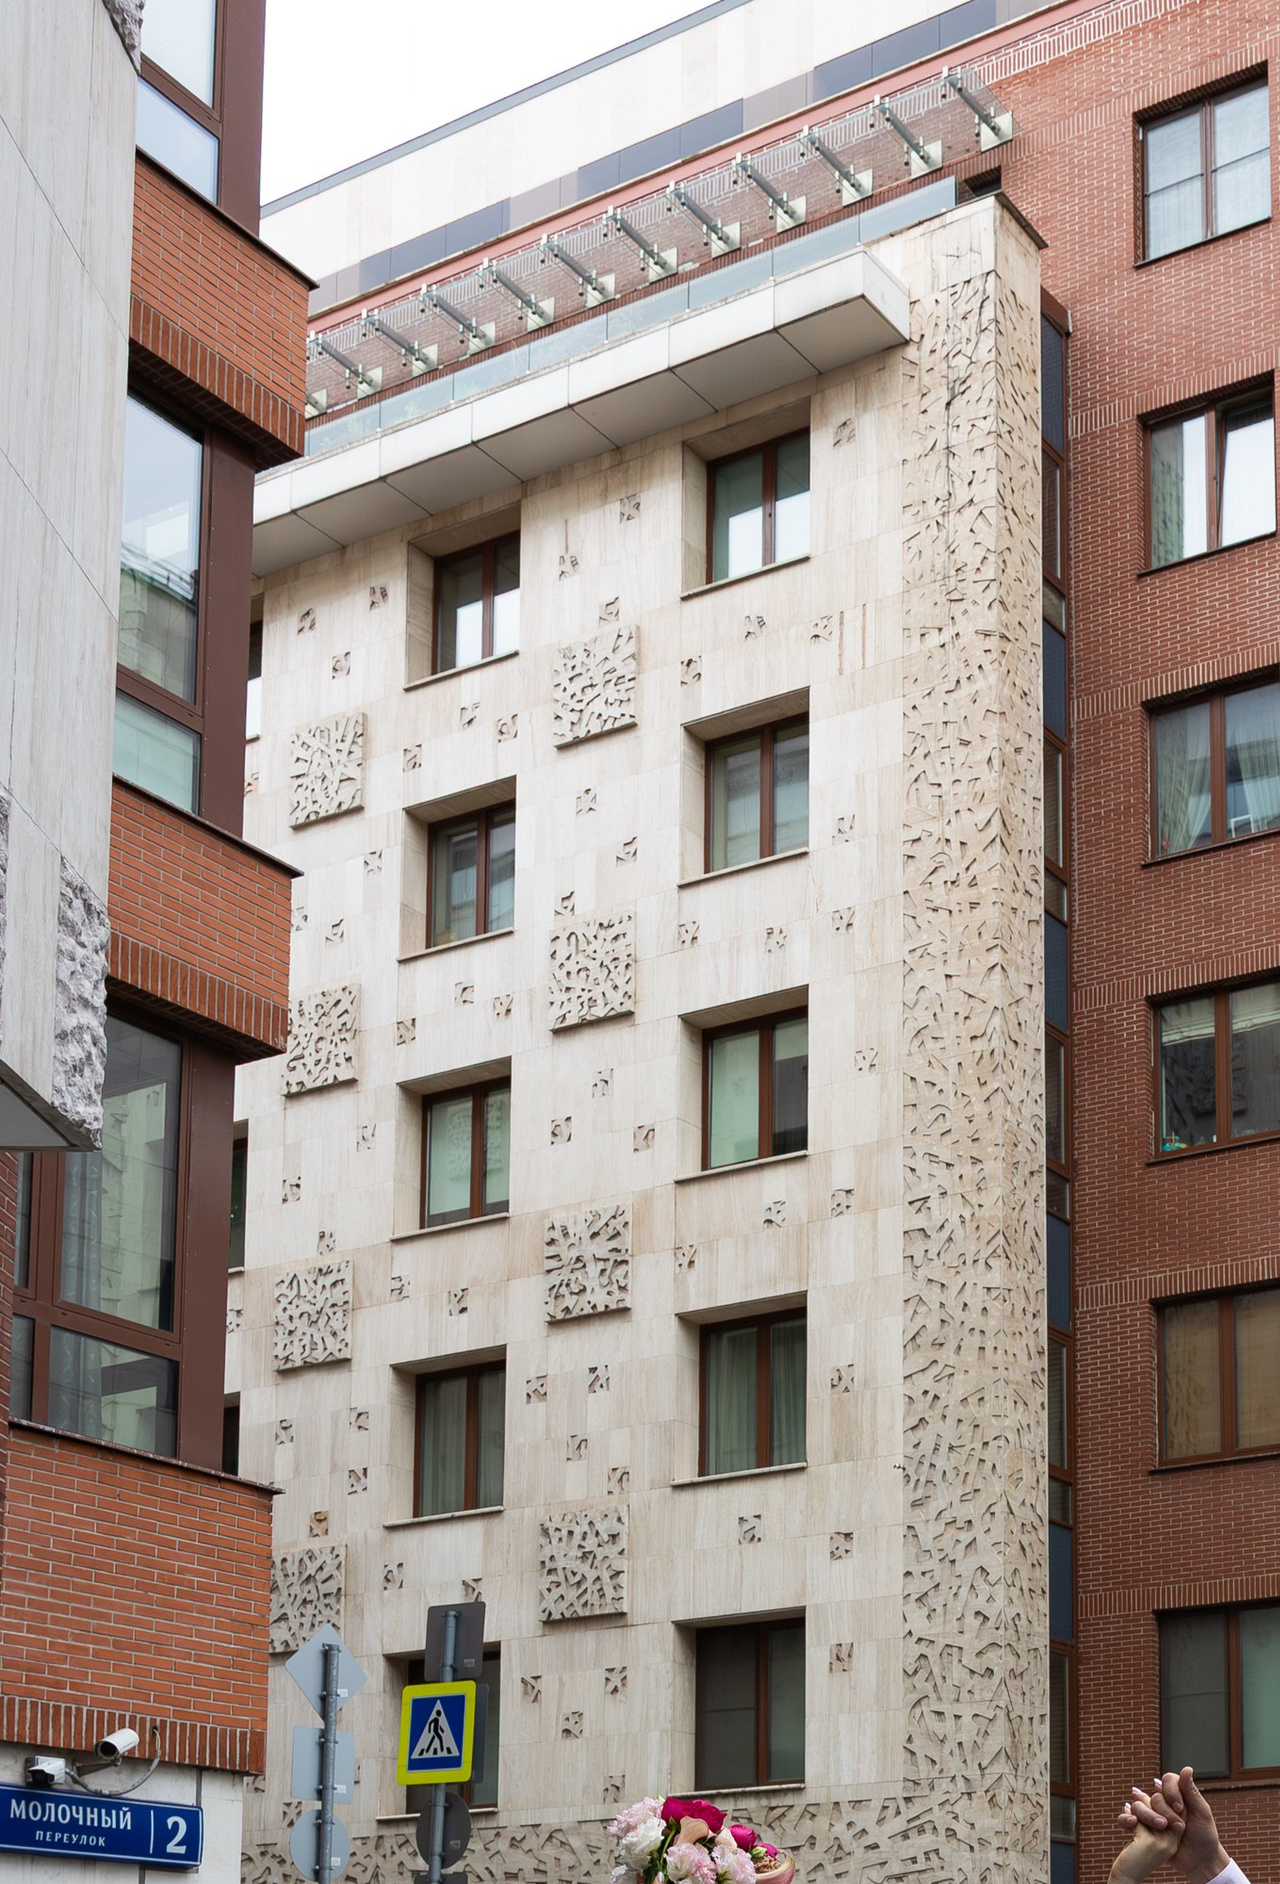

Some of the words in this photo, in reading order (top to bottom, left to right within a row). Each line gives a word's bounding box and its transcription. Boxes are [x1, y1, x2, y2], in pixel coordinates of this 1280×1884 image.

[10, 1798, 132, 1830] МОЛОЧНЫЙ
[35, 1830, 106, 1847] ПЕРЕУЛОК
[166, 1816, 187, 1854] 2
